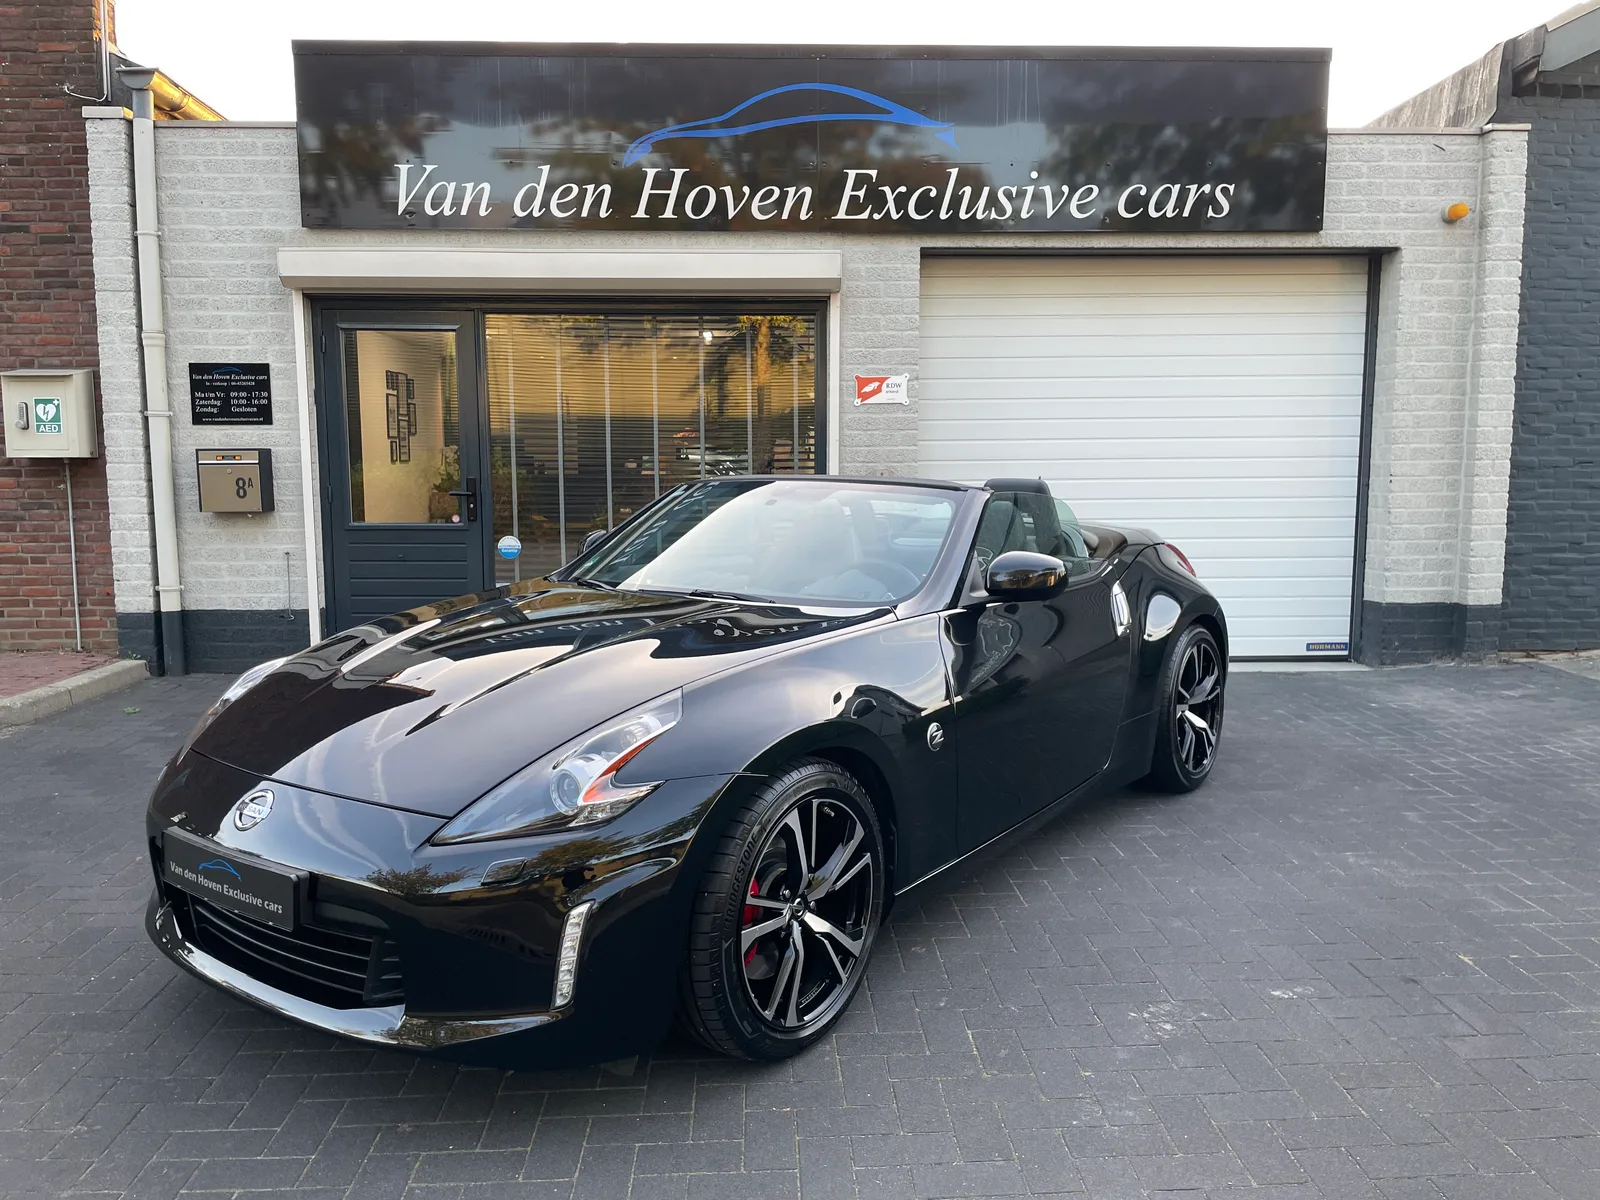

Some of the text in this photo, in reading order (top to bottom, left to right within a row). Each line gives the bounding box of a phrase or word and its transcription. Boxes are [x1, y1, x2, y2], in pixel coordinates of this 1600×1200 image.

[394, 163, 1235, 221] Van den Hoven Exclusive cars
[195, 406, 220, 414] Zondag:
[39, 424, 59, 433] AED
[170, 861, 284, 915] Van den Hoven Exclusive cars
